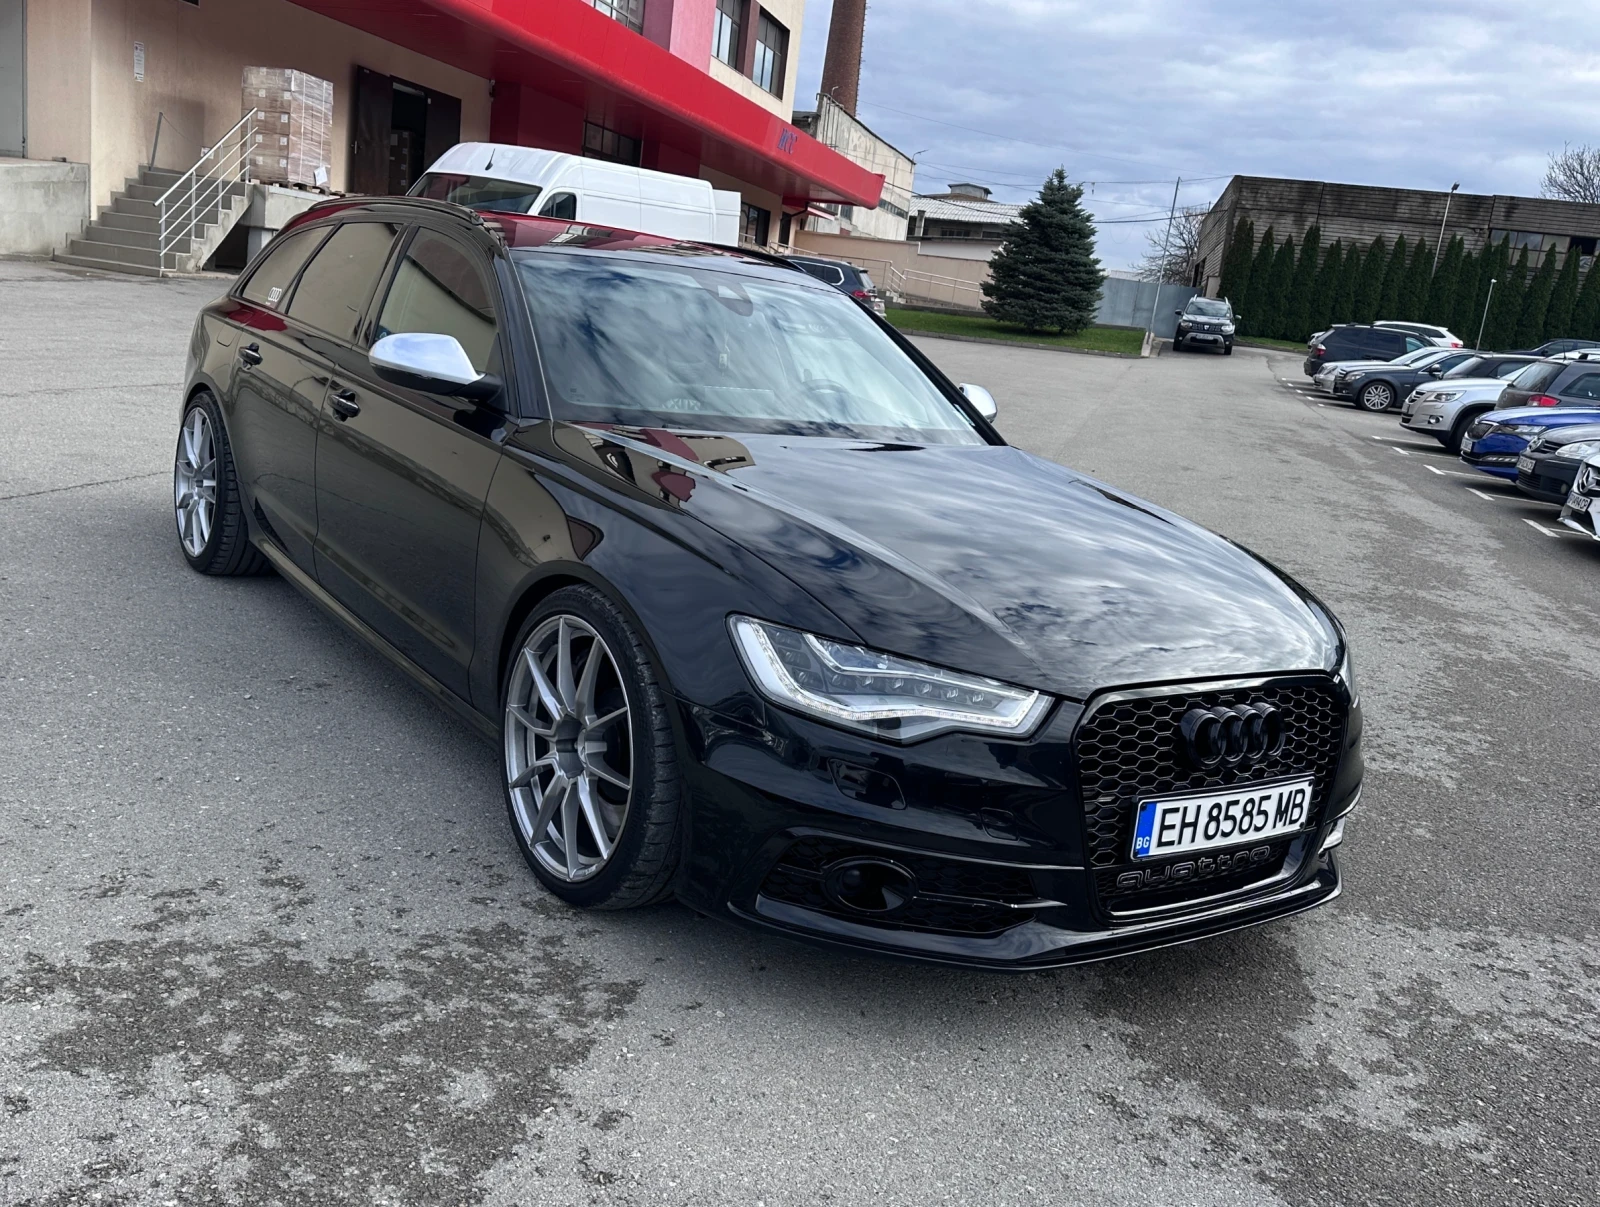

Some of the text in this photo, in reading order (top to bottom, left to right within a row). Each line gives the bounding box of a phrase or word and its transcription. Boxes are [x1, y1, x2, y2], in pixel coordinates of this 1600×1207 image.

[1156, 787, 1306, 848] EH 8585 MB
[1135, 836, 1150, 849] BG
